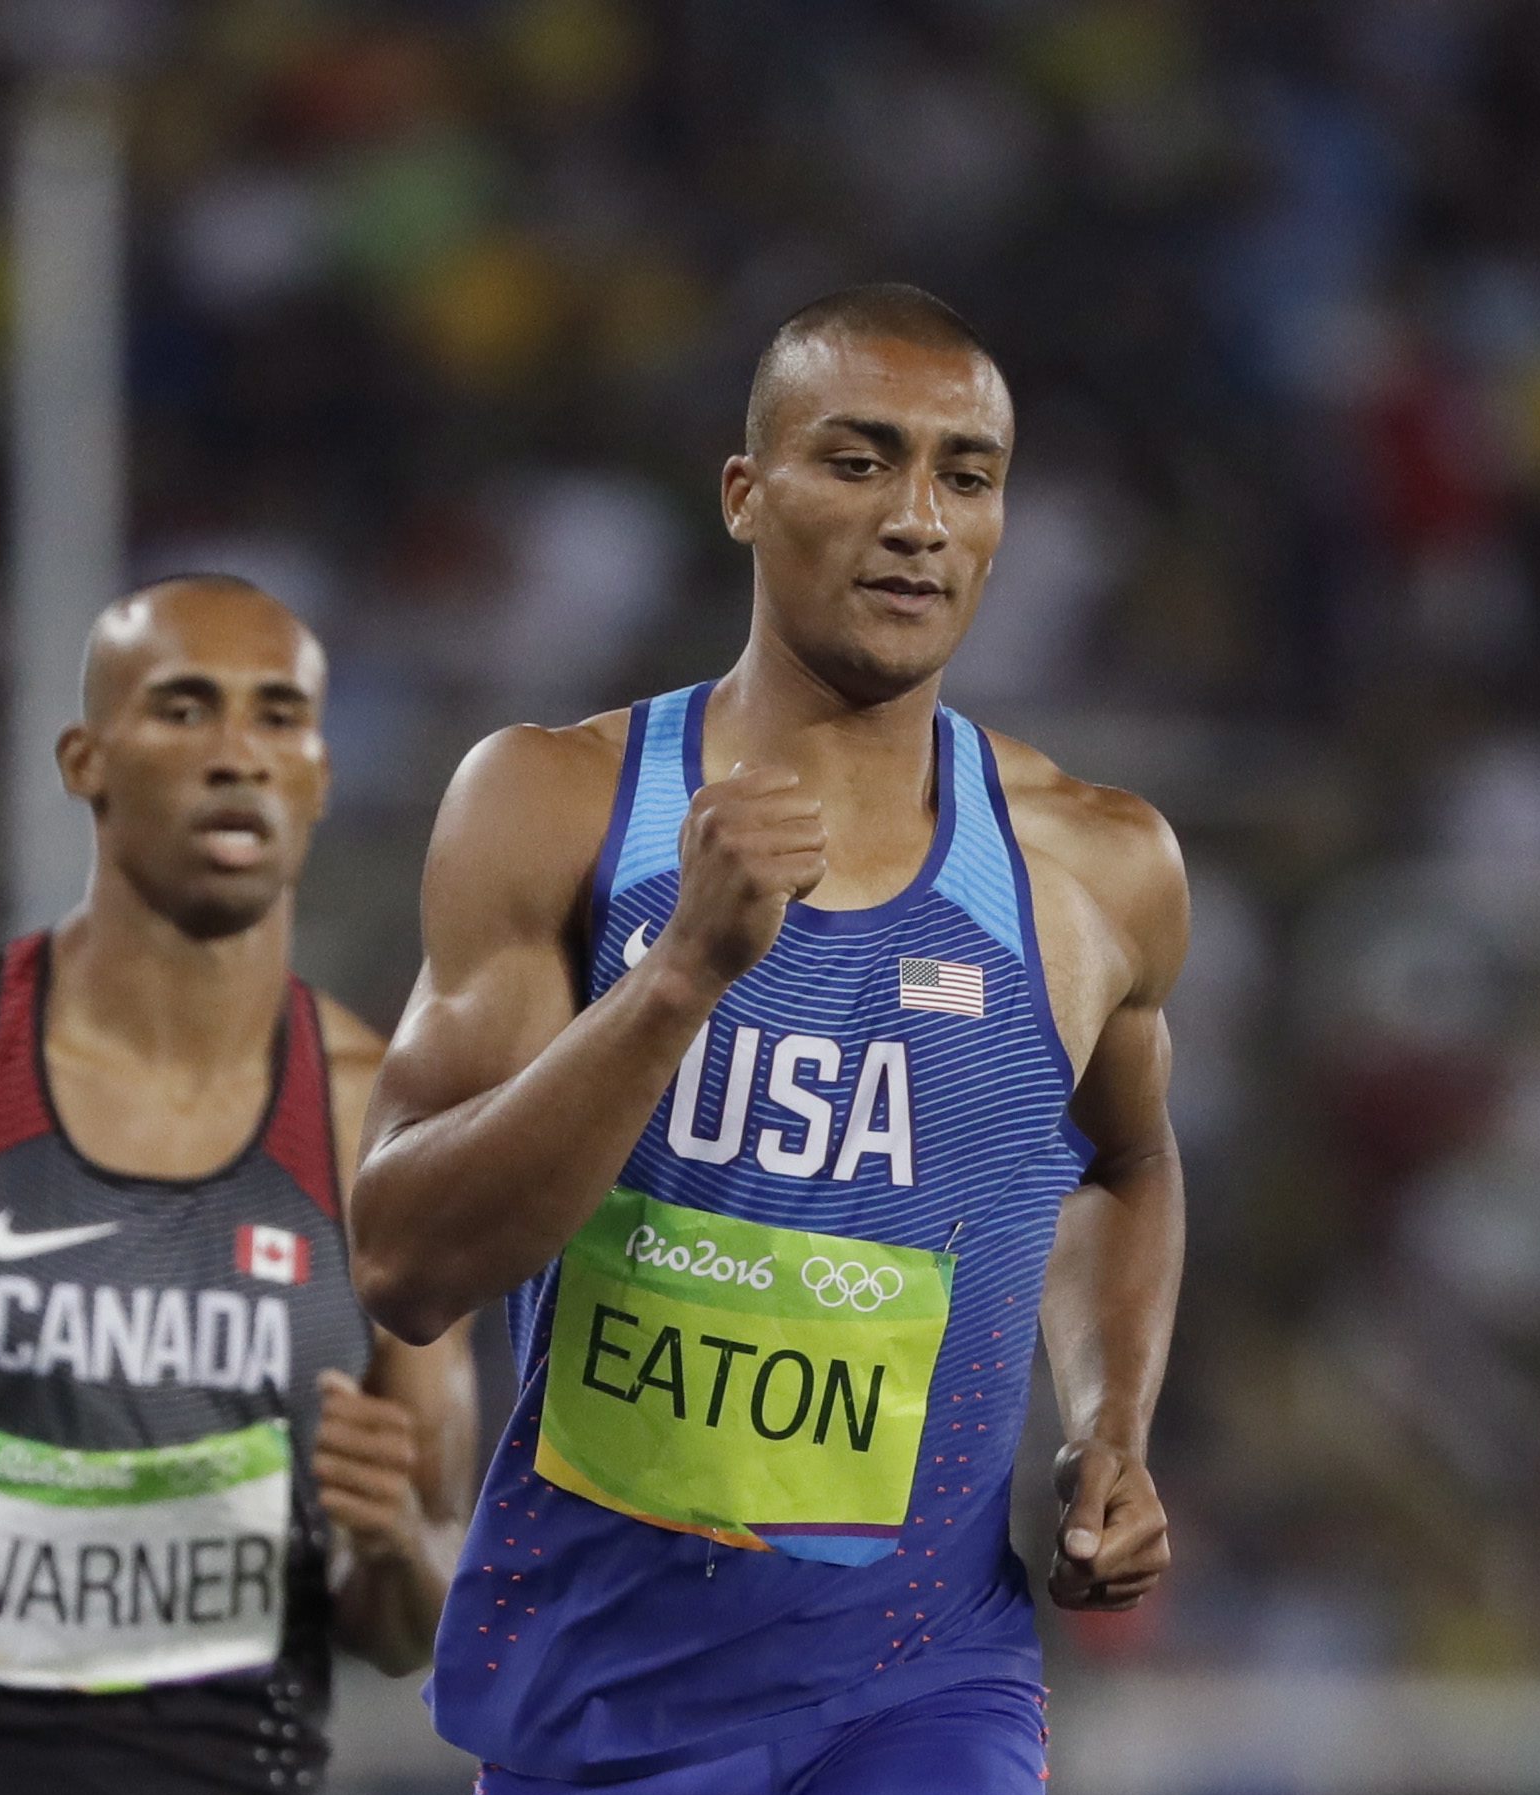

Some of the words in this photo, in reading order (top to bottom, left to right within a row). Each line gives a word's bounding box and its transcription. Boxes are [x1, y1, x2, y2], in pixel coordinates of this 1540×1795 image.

[667, 1022, 914, 1188] USA
[625, 1223, 774, 1291] Rio2016
[582, 1300, 885, 1453] EATON
